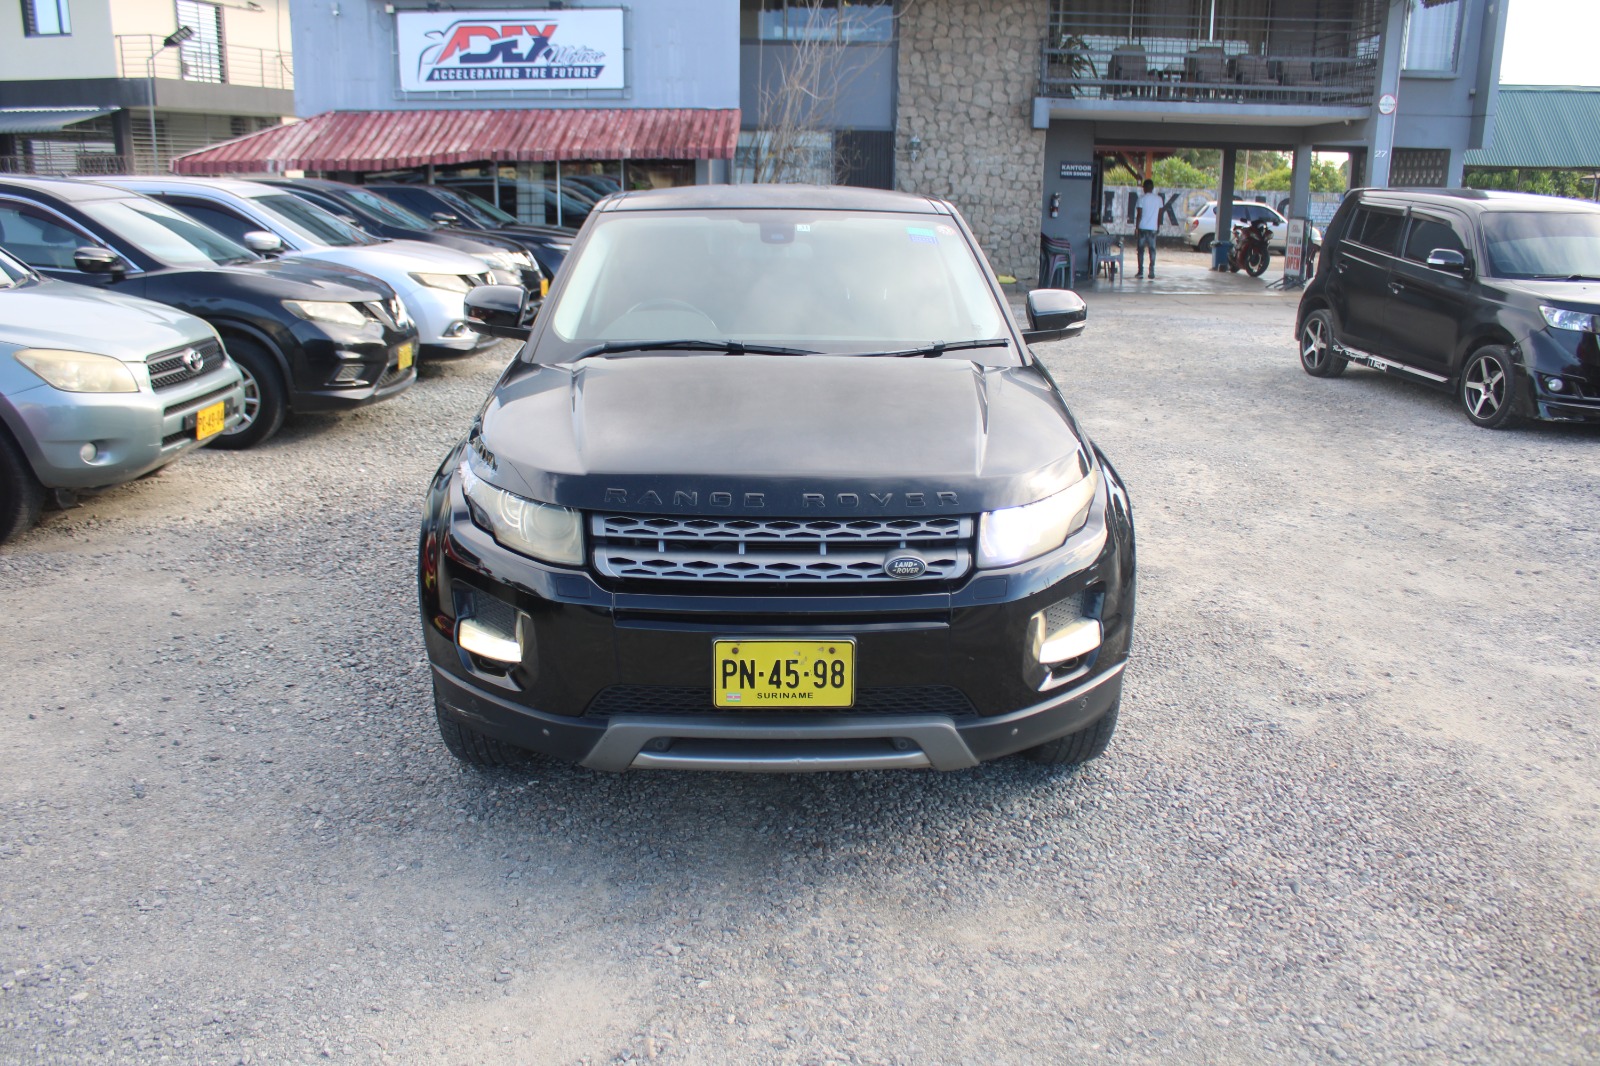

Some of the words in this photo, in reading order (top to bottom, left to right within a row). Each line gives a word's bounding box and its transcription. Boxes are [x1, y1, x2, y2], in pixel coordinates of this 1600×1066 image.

[436, 25, 558, 65] ADEX
[541, 44, 606, 67] Motors
[433, 68, 520, 80] ACCELERATING
[525, 67, 547, 79] THE
[551, 66, 597, 78] FUTURE
[1374, 150, 1388, 158] 27
[1286, 256, 1300, 270] OPEN
[605, 487, 765, 508] RANGE
[802, 491, 959, 507] ROVER
[757, 692, 814, 700] SURINAME
